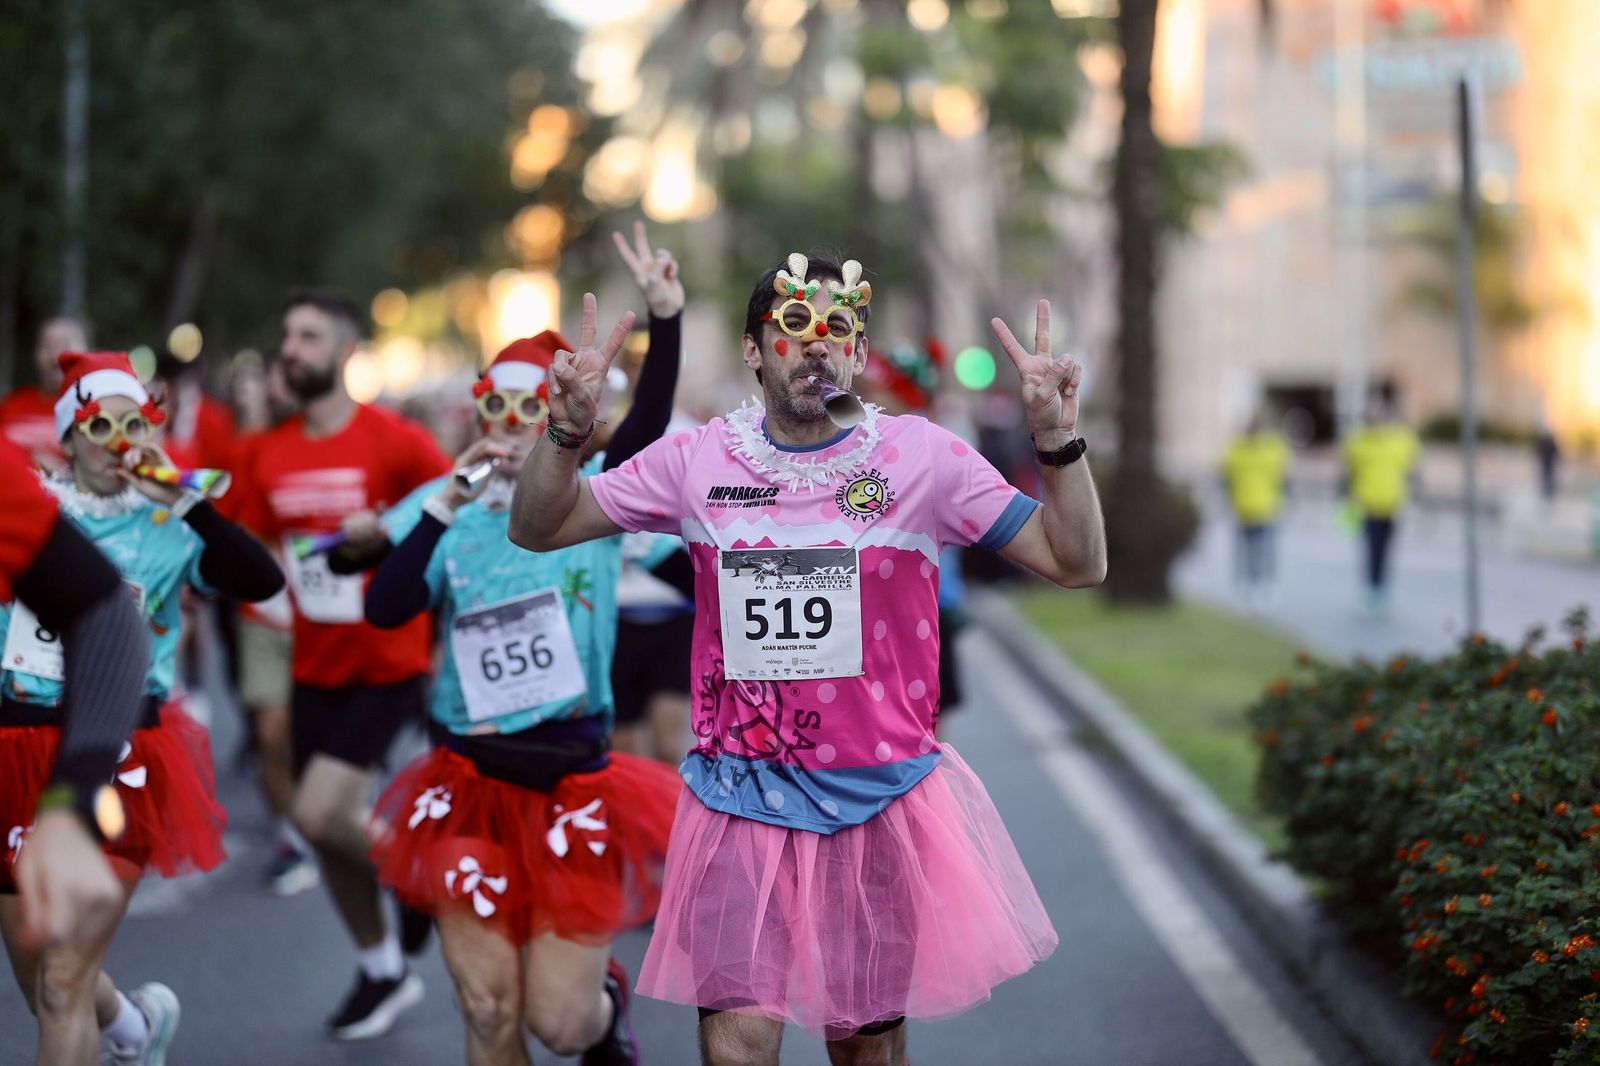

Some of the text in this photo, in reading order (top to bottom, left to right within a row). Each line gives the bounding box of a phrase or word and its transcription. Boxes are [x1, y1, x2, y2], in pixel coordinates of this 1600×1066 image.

[707, 486, 780, 501] IMPARABLES
[835, 485, 859, 521] LENGUA
[876, 490, 895, 516] SACA
[861, 514, 875, 523] LA
[810, 565, 856, 575] XIV
[745, 596, 833, 641] 519
[481, 634, 553, 682] 656
